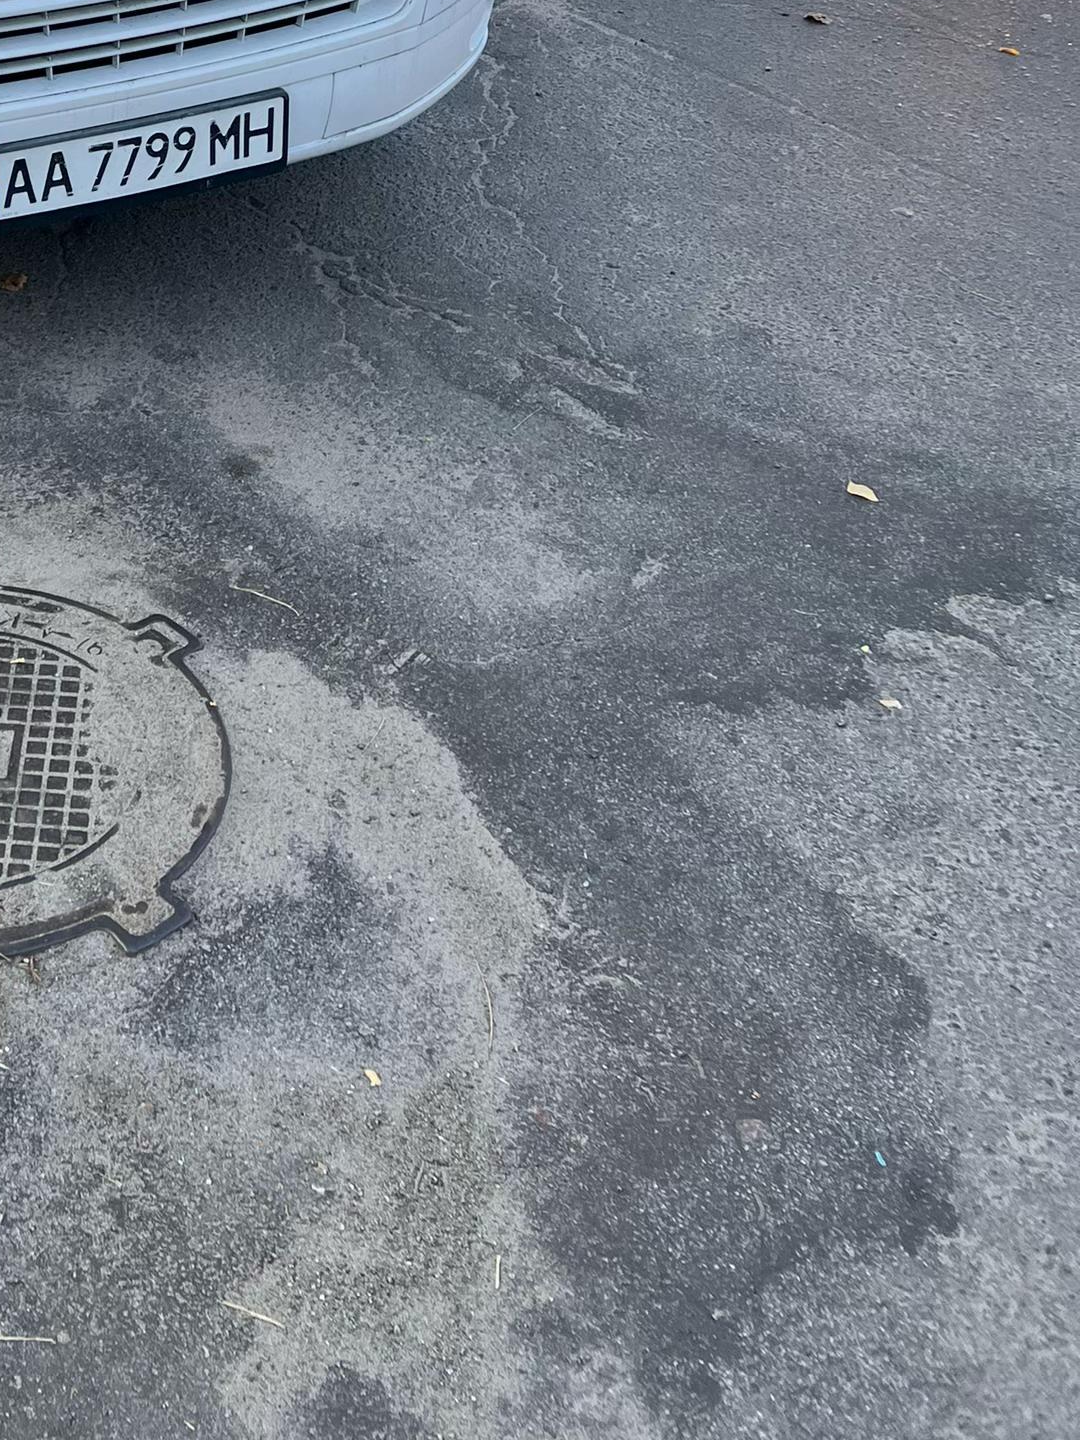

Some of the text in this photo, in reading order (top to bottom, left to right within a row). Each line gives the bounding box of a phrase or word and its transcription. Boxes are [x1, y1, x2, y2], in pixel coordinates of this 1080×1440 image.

[4, 107, 274, 209] AA 7799 MH
